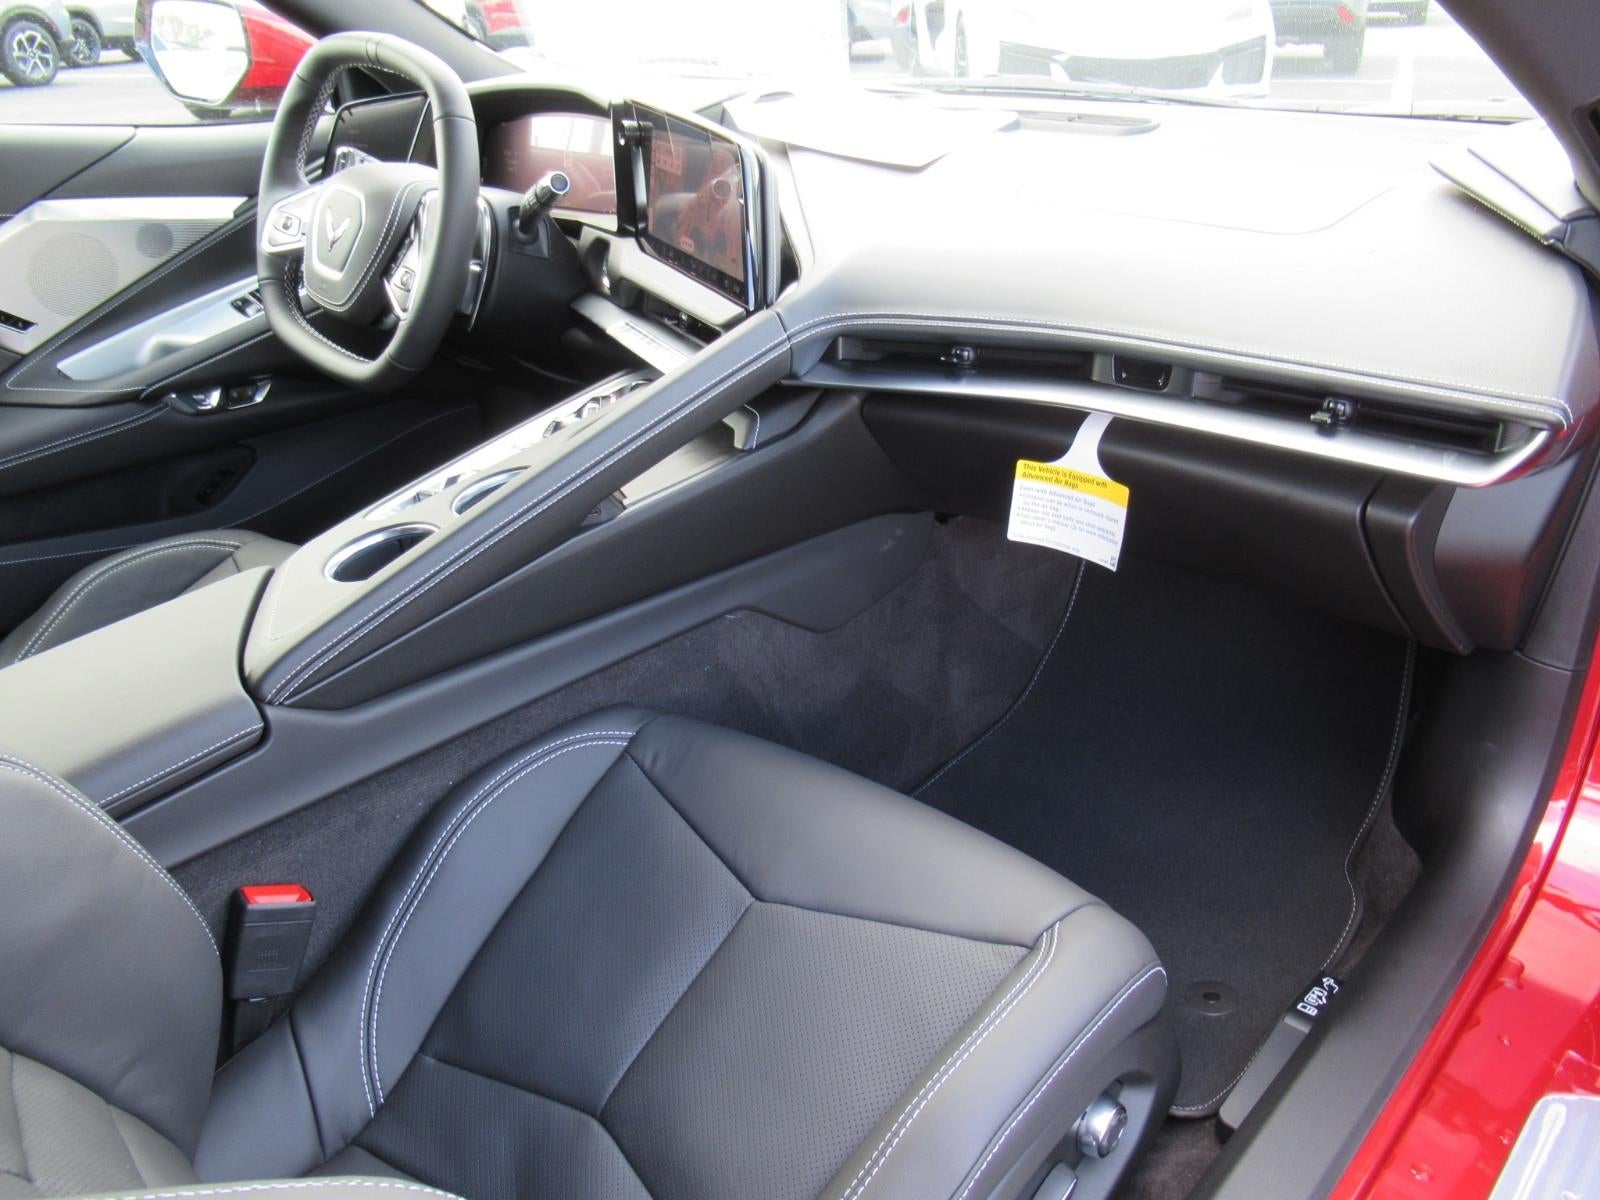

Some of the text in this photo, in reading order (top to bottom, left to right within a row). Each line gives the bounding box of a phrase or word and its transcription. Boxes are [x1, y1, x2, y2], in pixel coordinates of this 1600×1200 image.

[1022, 472, 1079, 489] Advanced Air Bags
[1023, 464, 1036, 472] This
[1039, 466, 1060, 476] Vehicle
[1069, 472, 1095, 485] Equipped
[1096, 480, 1107, 489] with
